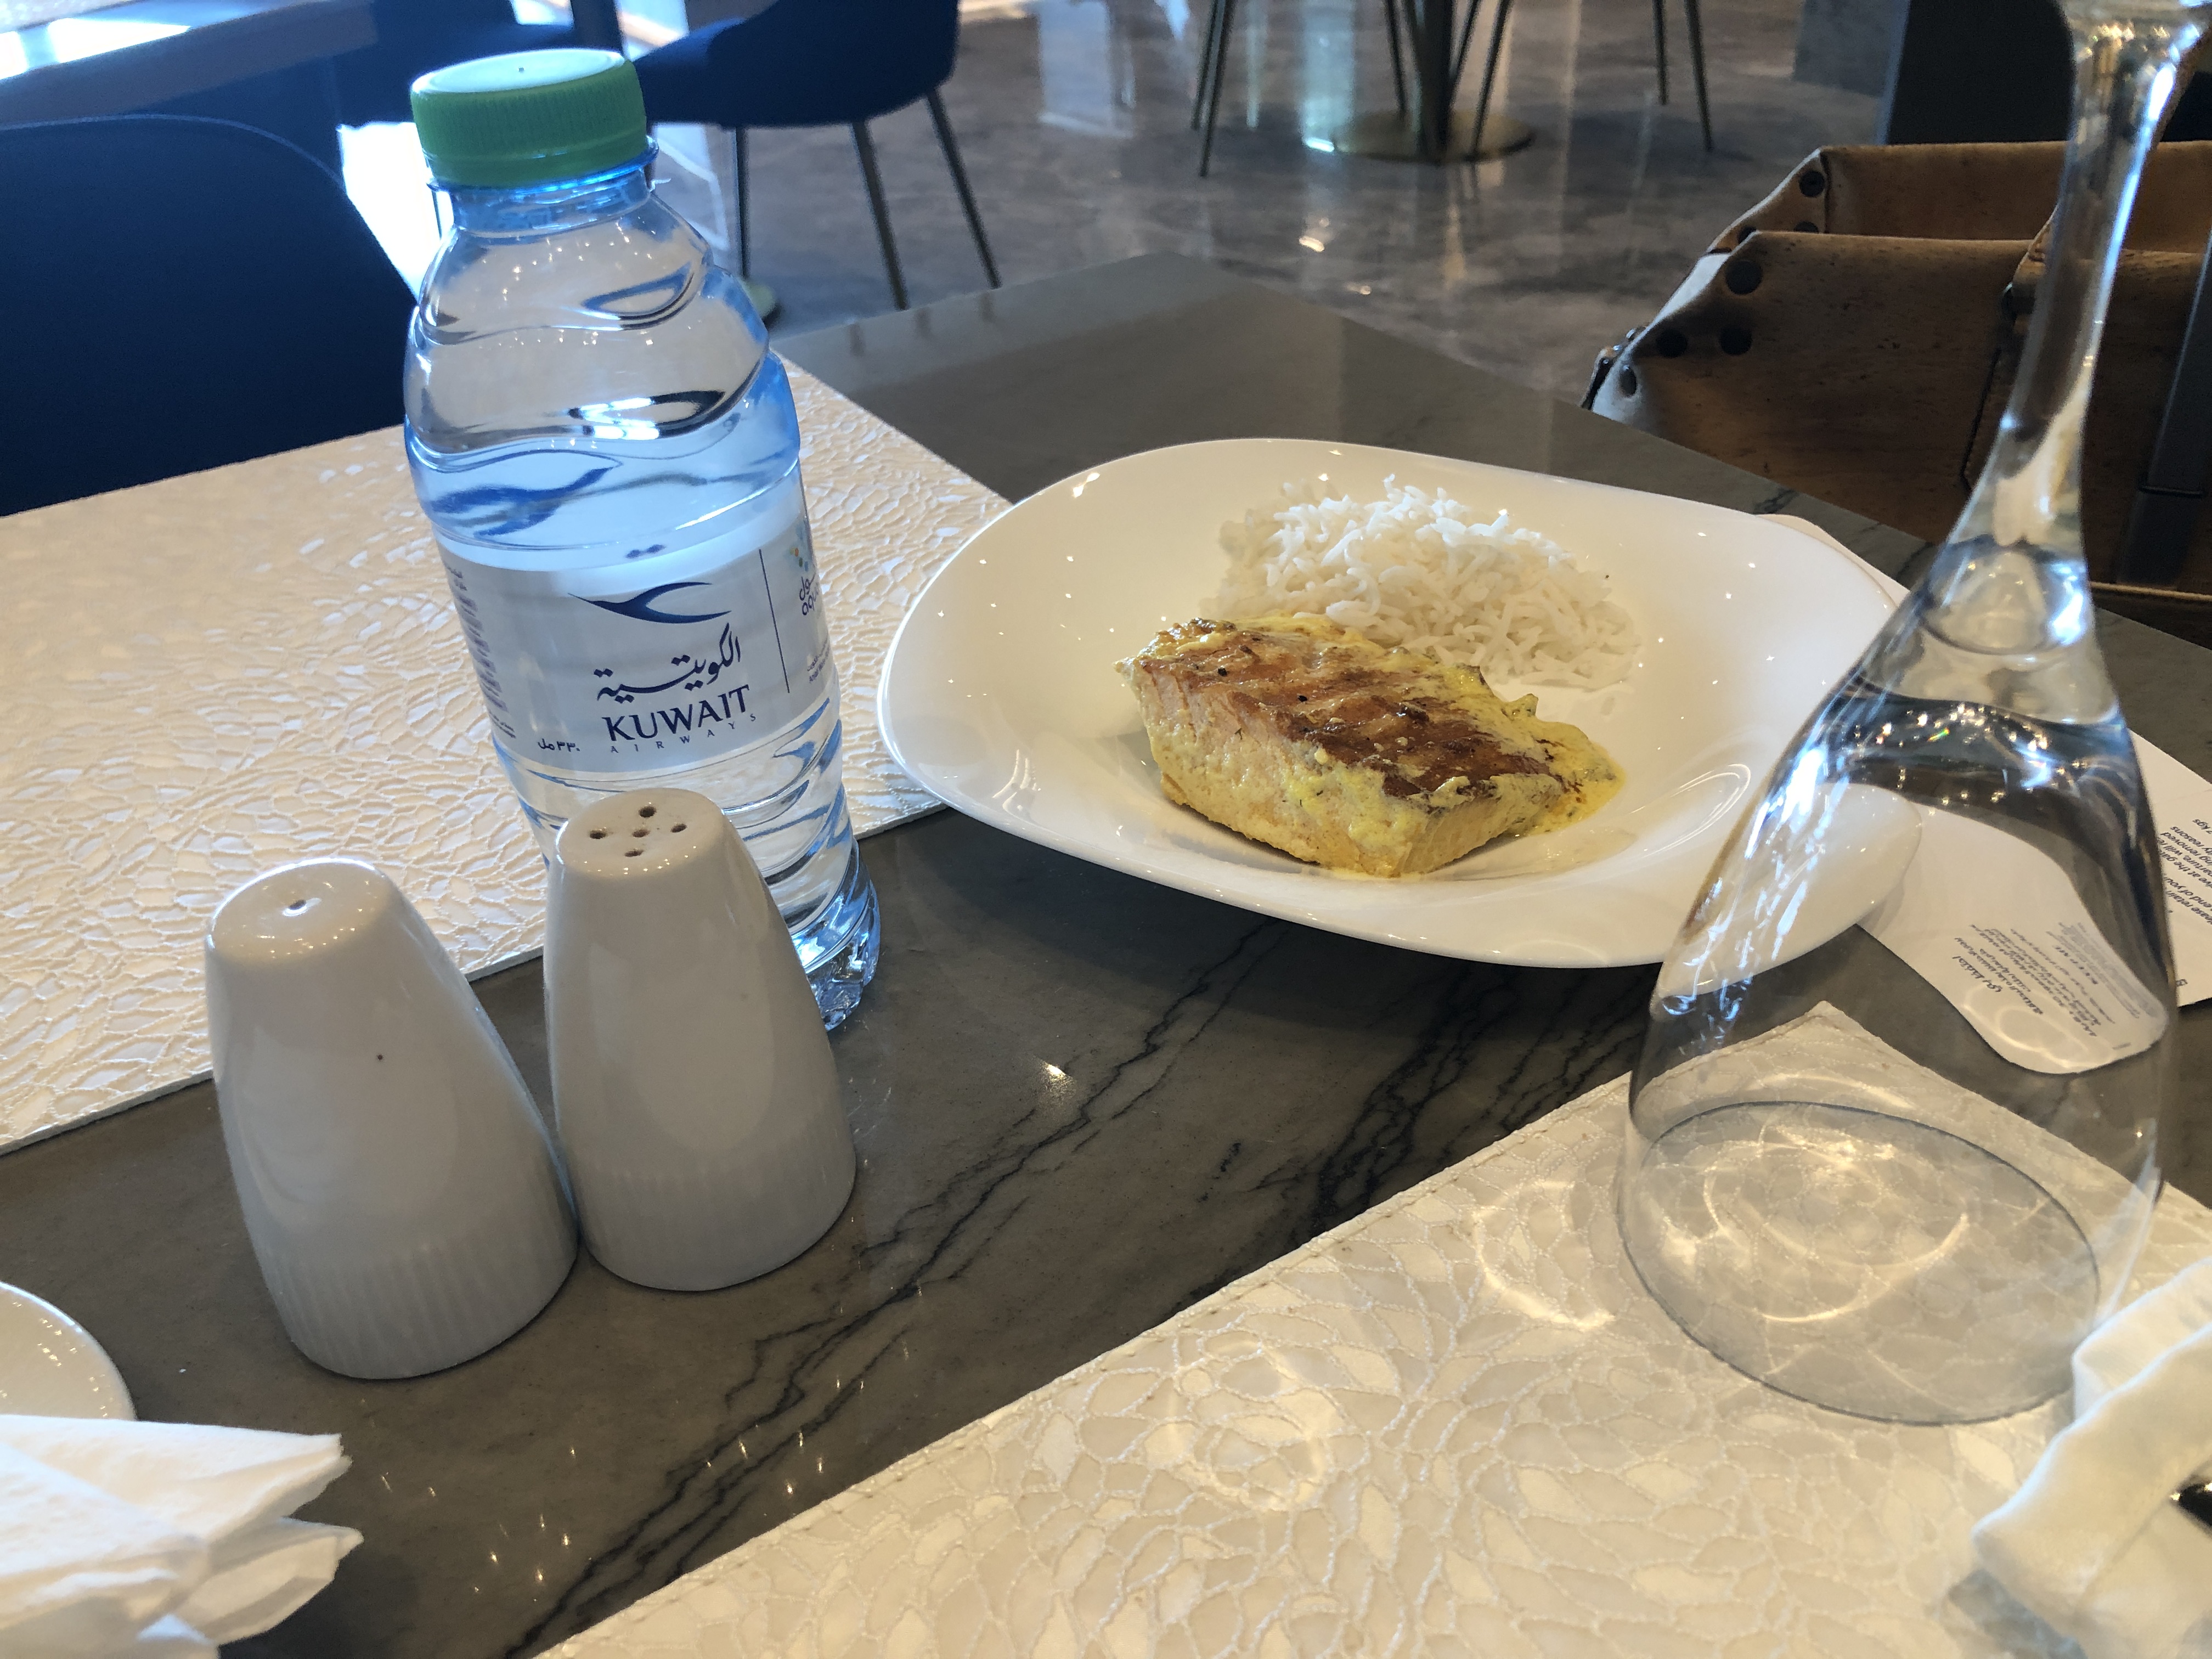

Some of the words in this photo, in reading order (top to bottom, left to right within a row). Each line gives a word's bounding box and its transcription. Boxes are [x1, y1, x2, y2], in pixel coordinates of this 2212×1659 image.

[601, 684, 750, 747] KUWAIT
[610, 713, 757, 754] AIRWAYS
[2160, 832, 2202, 856] removed
[2170, 826, 2205, 847] reasons
[2163, 845, 2183, 856] will
[2174, 862, 2191, 872] the
[2188, 896, 2212, 908] end
[2191, 907, 2212, 925] lease
